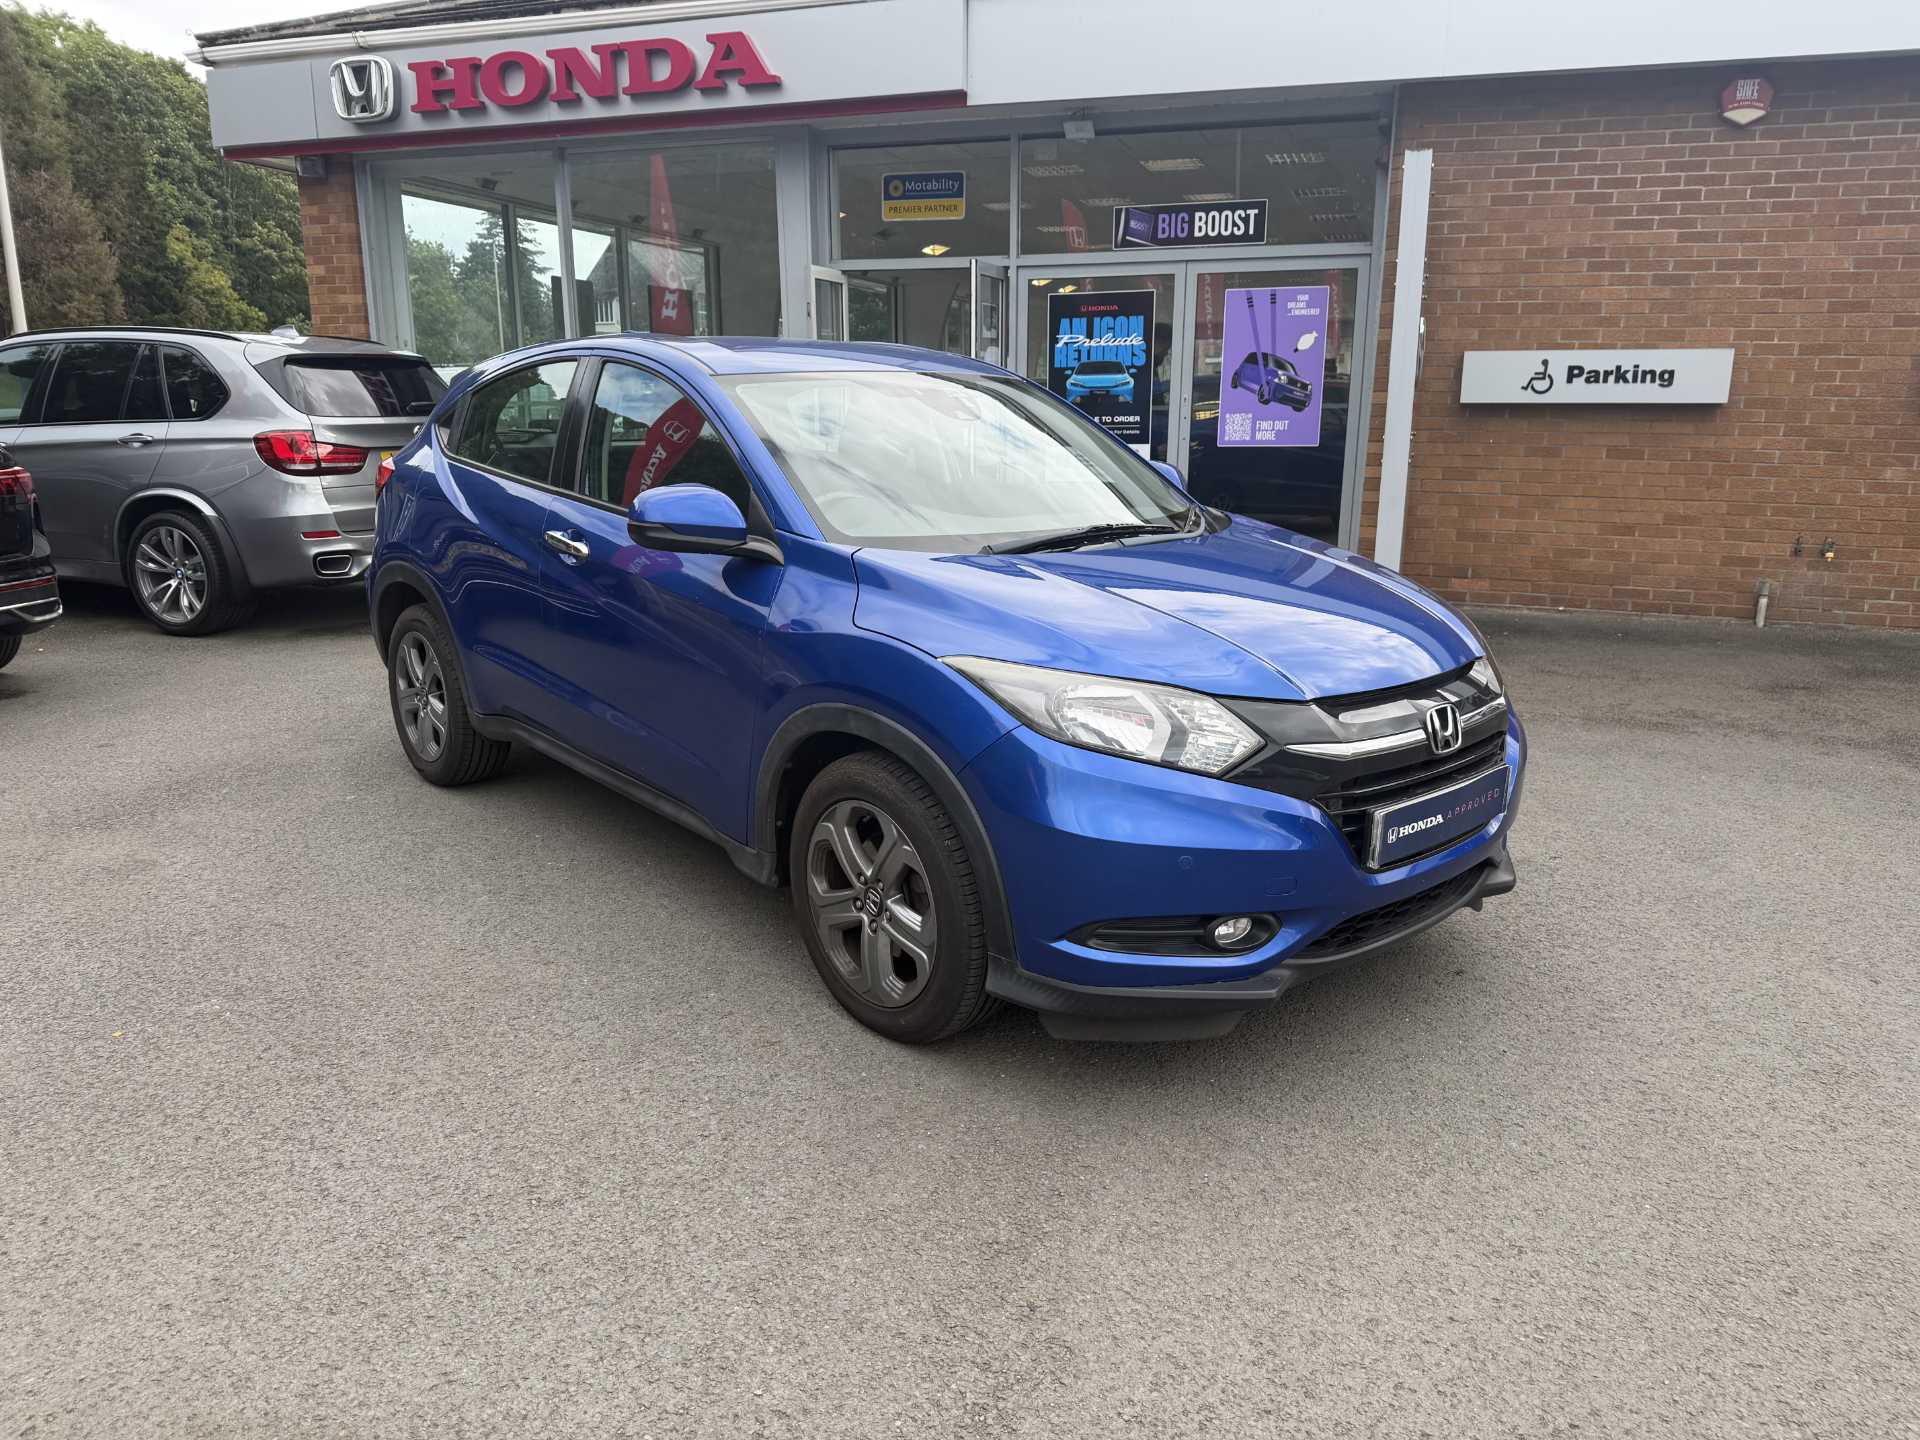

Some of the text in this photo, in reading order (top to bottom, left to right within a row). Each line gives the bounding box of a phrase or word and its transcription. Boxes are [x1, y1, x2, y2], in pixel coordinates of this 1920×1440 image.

[407, 31, 783, 113] HONDA
[905, 178, 960, 192] Motability
[889, 204, 959, 214] PREMIER PARTNER
[1157, 208, 1259, 239] BIG BOOST
[1059, 315, 1145, 339] AN ICON
[1056, 332, 1145, 348] Prelude
[1054, 342, 1148, 368] RETURNS
[1566, 364, 1676, 388] Parking
[1101, 415, 1113, 423] TO
[1113, 415, 1141, 423] ORDER
[1256, 420, 1289, 431] FIND OUT
[1256, 430, 1277, 441] MORE
[1398, 788, 1500, 838] HONDA APPROVED
